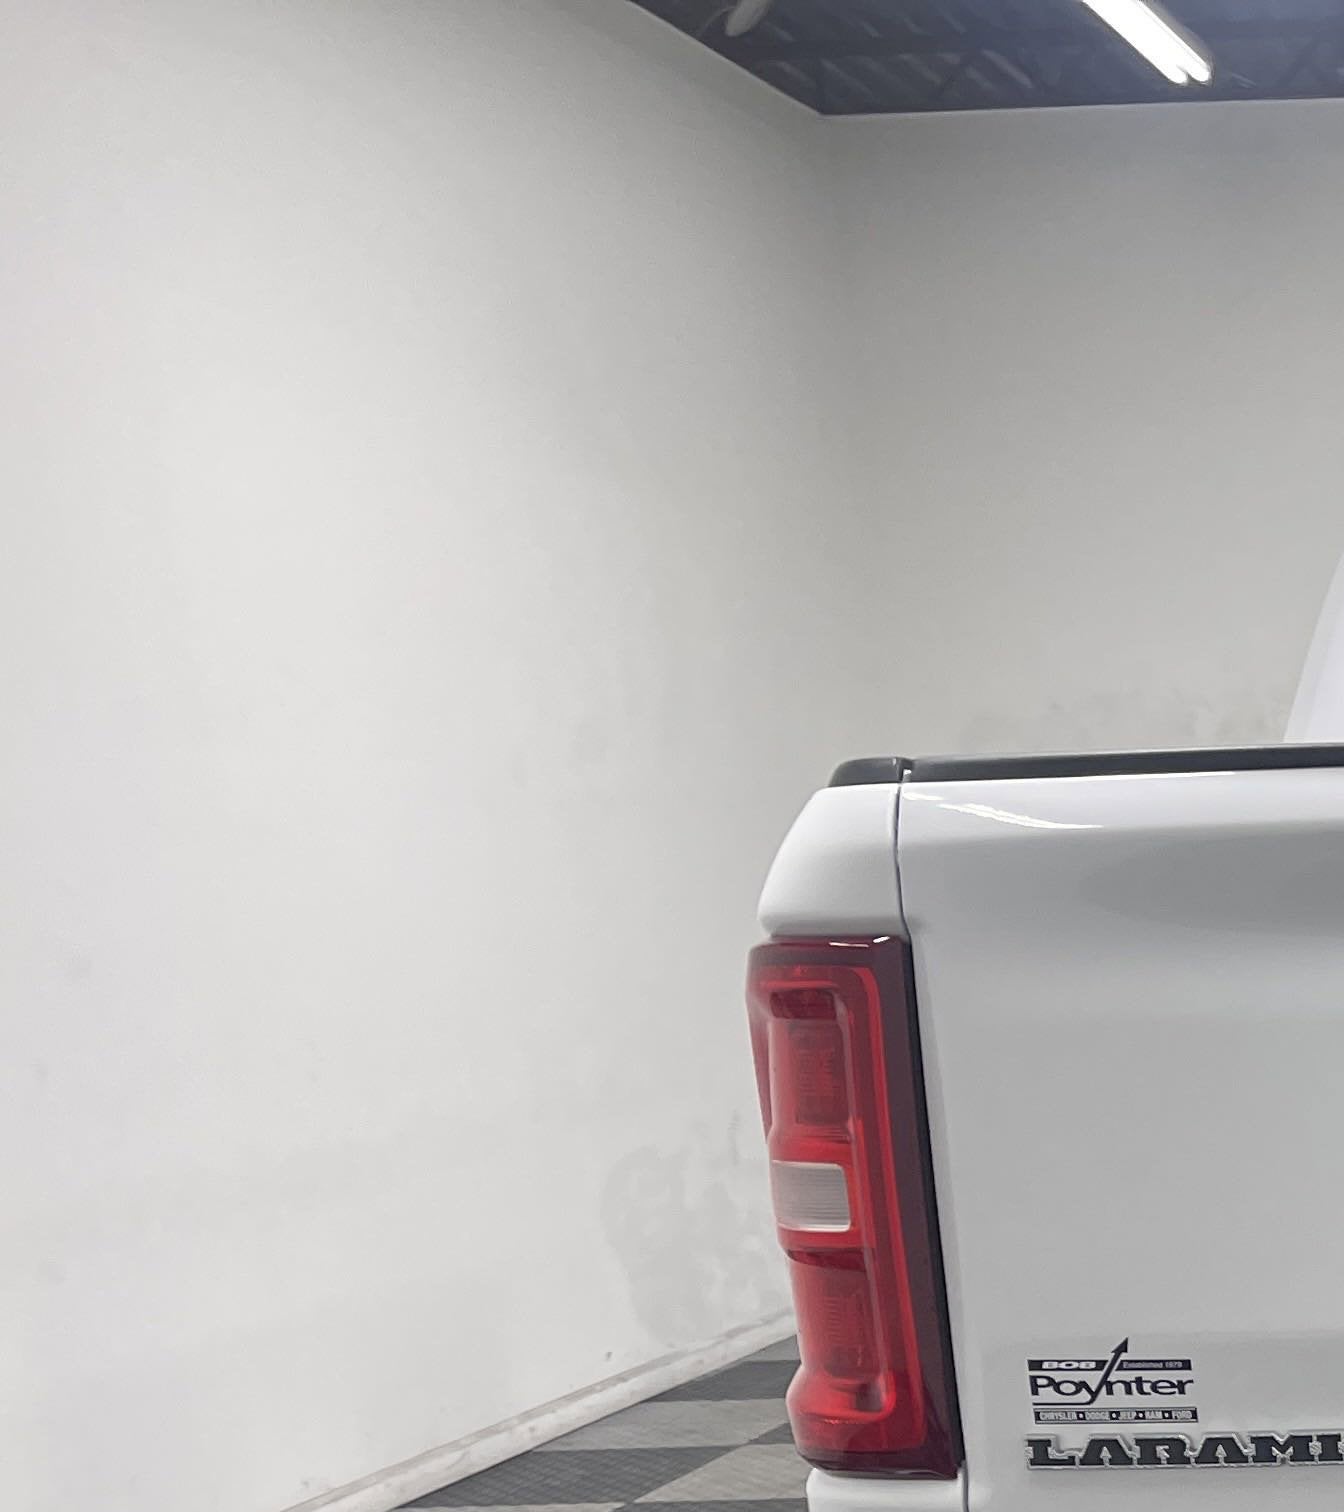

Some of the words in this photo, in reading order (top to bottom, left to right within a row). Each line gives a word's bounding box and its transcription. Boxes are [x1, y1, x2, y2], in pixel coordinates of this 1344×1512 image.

[1042, 1361, 1097, 1370] BOB
[1029, 1375, 1194, 1405] Poynter
[1039, 1411, 1077, 1421] CHRYSLER
[1172, 1410, 1193, 1420] FORD
